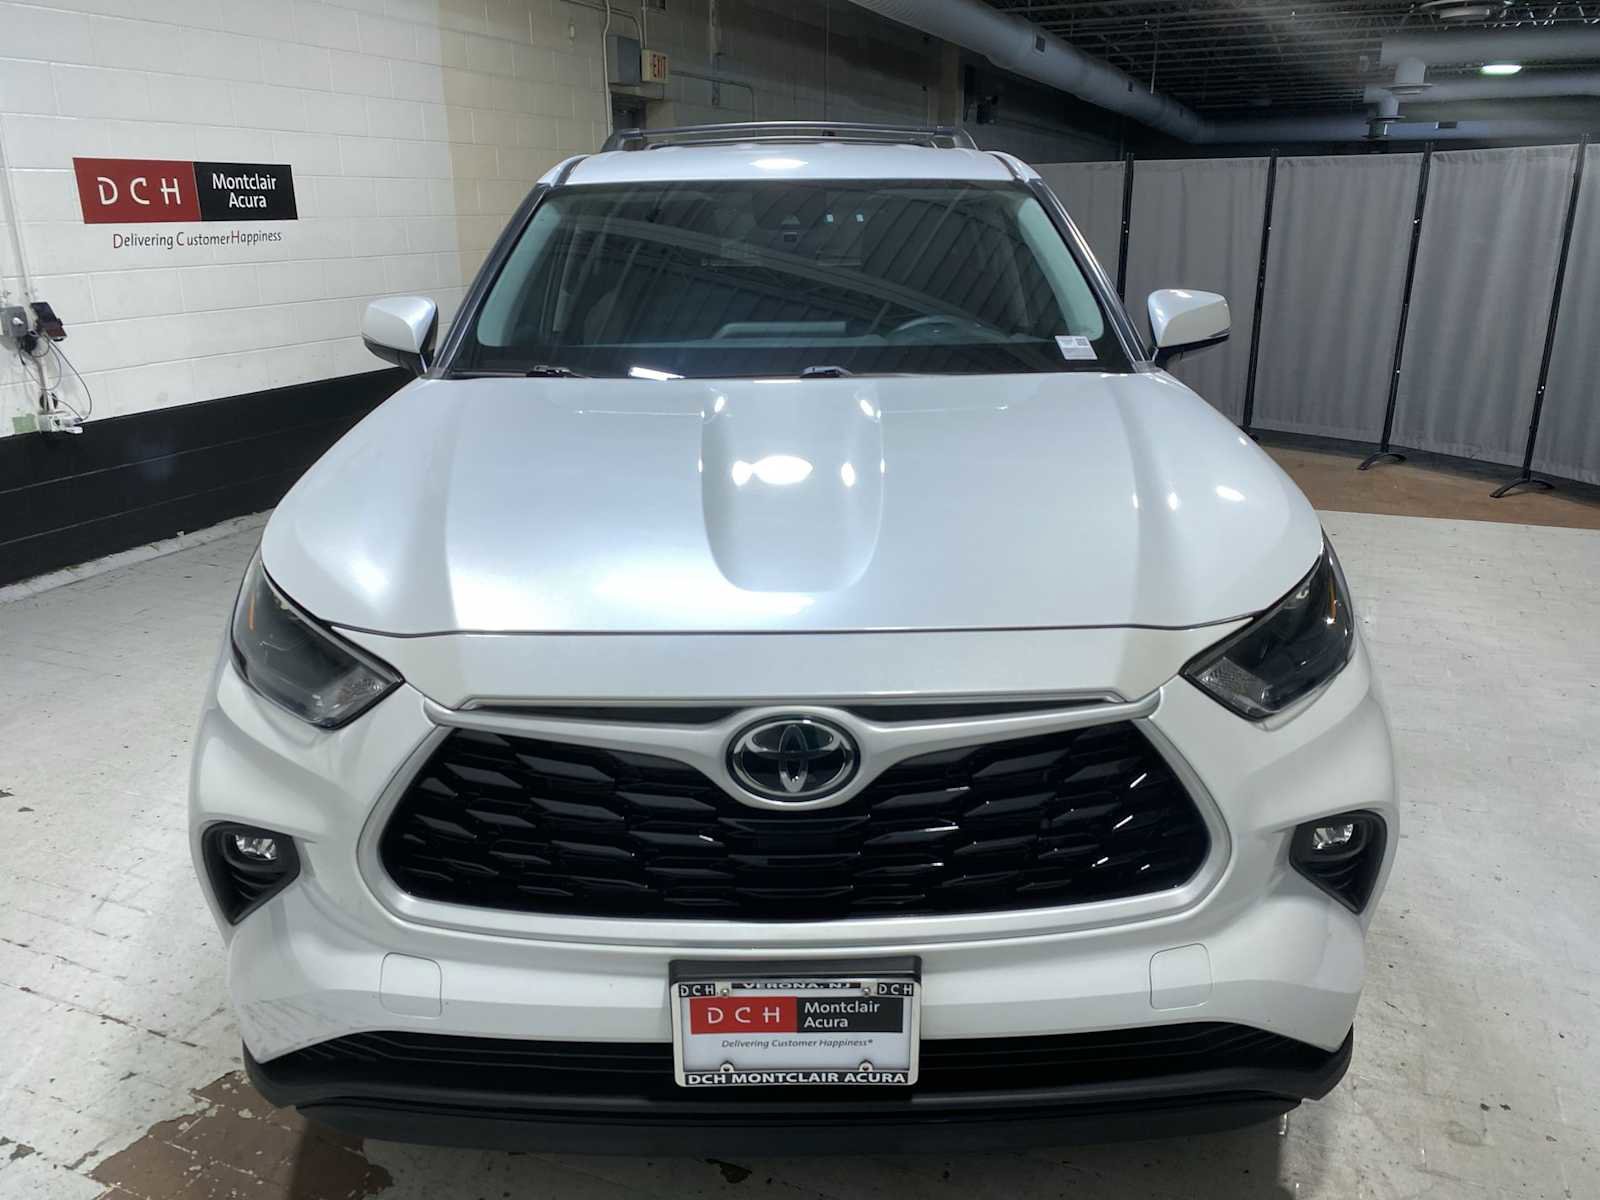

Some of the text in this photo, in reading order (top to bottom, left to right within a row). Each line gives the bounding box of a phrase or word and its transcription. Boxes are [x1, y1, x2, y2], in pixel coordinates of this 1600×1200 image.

[652, 54, 667, 80] EXIT
[212, 173, 277, 190] Montclair
[228, 192, 267, 208] Acura
[113, 233, 173, 249] Delivering
[680, 984, 715, 997] DCH
[879, 984, 913, 995] DCH
[804, 1001, 880, 1014] Montclair
[707, 1007, 780, 1024] DCH
[804, 1017, 848, 1028] Acura
[721, 1039, 769, 1049] Delivering
[771, 1039, 817, 1048] Customer
[688, 1073, 905, 1084] DCH MONTCLAIR ACURA
